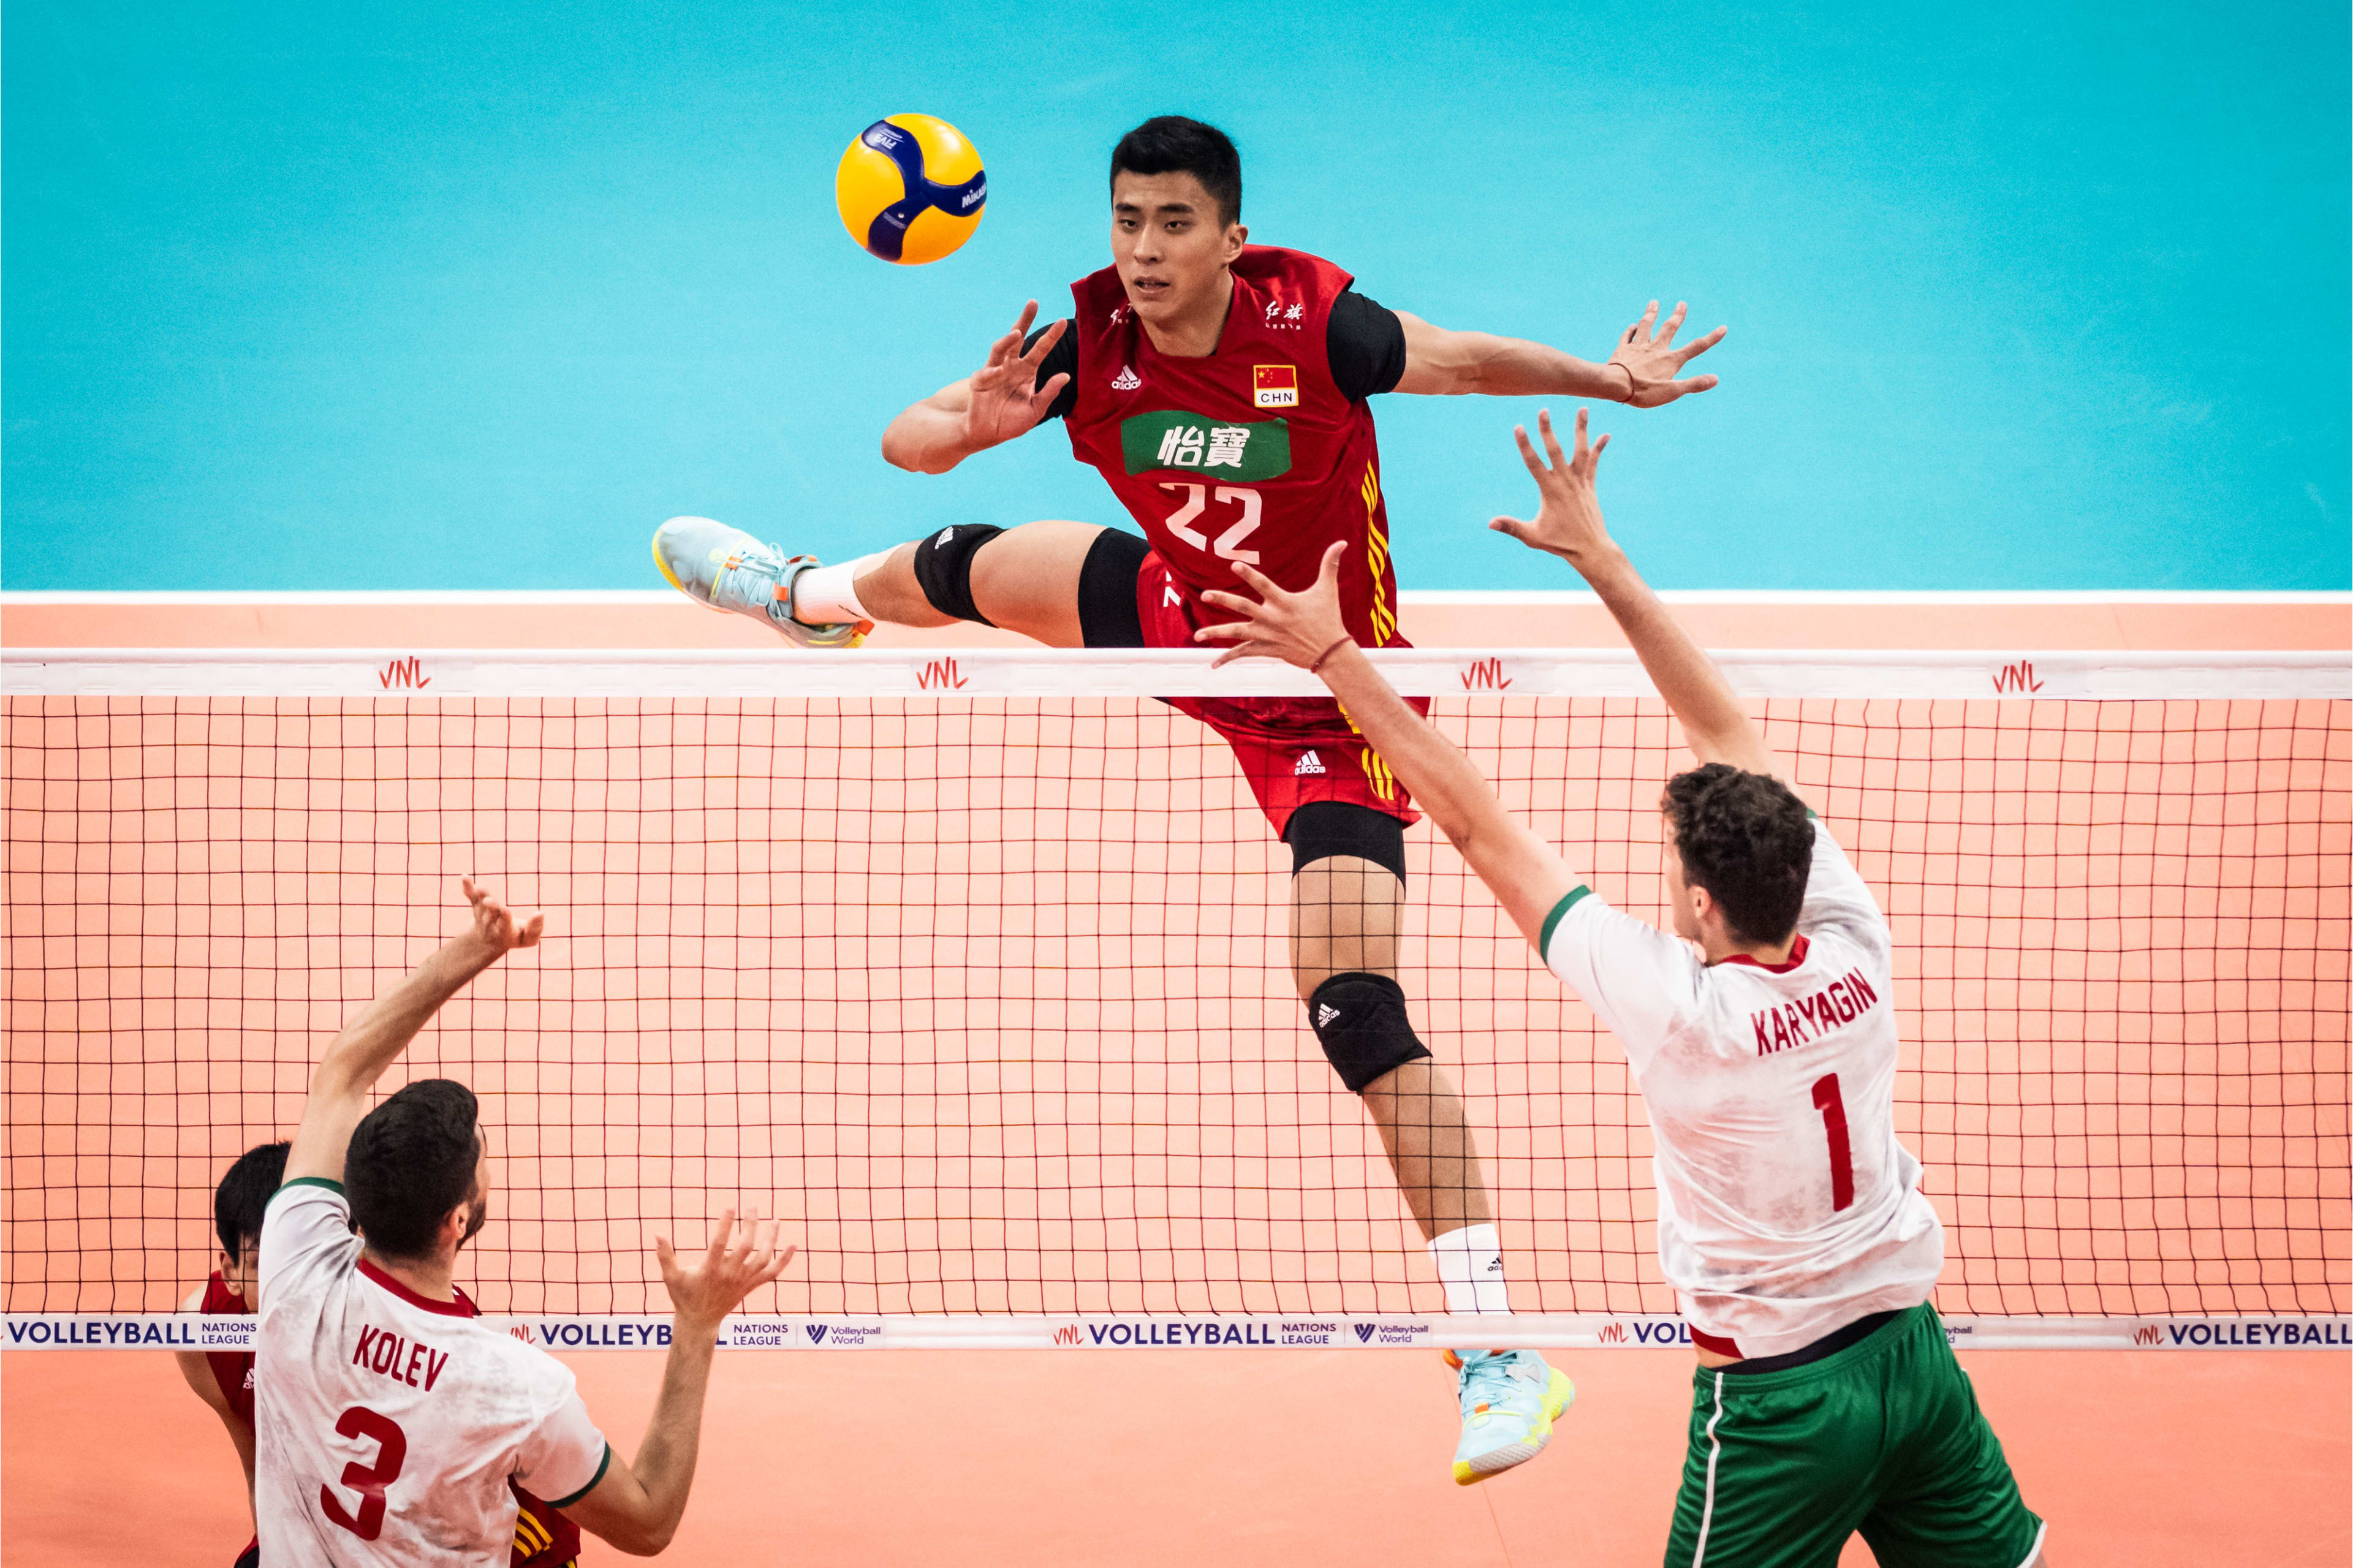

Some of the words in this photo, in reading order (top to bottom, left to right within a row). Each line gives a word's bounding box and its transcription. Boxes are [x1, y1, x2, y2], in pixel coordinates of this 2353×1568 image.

[1260, 392, 1292, 403] CHN
[1157, 426, 1251, 468] 怡寶
[1159, 483, 1262, 565] 22
[379, 656, 431, 689] VNL
[916, 656, 969, 689] VNL
[1460, 657, 1513, 690] VNL
[1992, 660, 2044, 694] VNL
[1751, 967, 1877, 1056] KARYAGIN
[1811, 1072, 1854, 1212] 1
[7, 1322, 195, 1344] VOLLEYBALL
[202, 1323, 257, 1332] NATIONS
[733, 1324, 789, 1333] NATIONS
[831, 1327, 881, 1336] Volleyball
[1053, 1324, 1084, 1345] VNL
[1088, 1324, 1276, 1344] VOLLEYBALL
[1282, 1324, 1336, 1332] NATIONS
[1379, 1325, 1429, 1335] Volleyball
[1598, 1322, 1629, 1343] VNL
[2133, 1324, 2164, 1346] VNL
[2169, 1324, 2352, 1344] VOLLEYBALL
[202, 1335, 249, 1344] LEAGUE
[733, 1336, 781, 1345] LEAGUE
[1282, 1335, 1329, 1344] LEAGUE
[1379, 1335, 1412, 1343] World
[352, 1324, 449, 1392] KOLEV
[320, 1406, 407, 1541] 3
